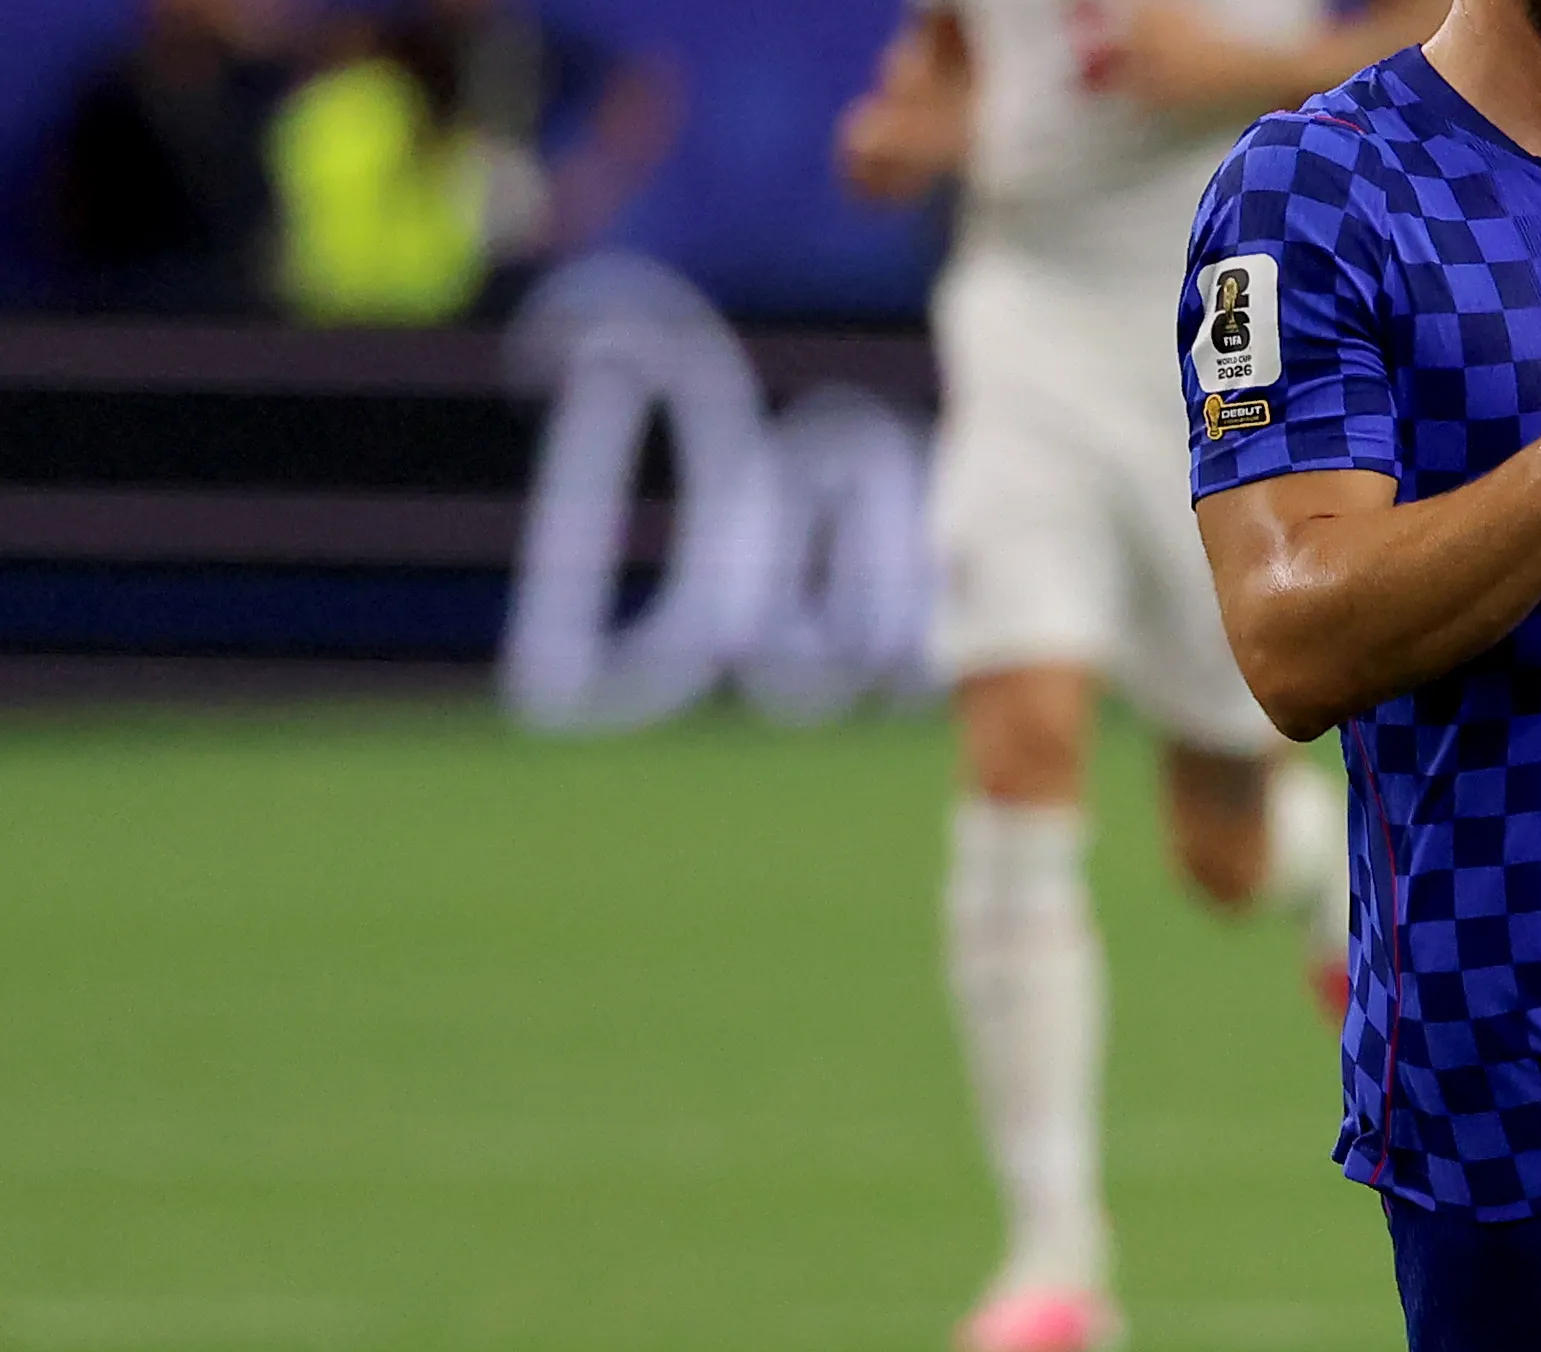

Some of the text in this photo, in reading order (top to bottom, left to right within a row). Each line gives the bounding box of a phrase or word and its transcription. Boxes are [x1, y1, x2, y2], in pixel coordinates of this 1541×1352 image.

[1223, 335, 1241, 346] FIFA
[1216, 355, 1252, 366] WORLD CUP
[1217, 364, 1252, 380] 2026
[1221, 405, 1262, 419] DEBUT
